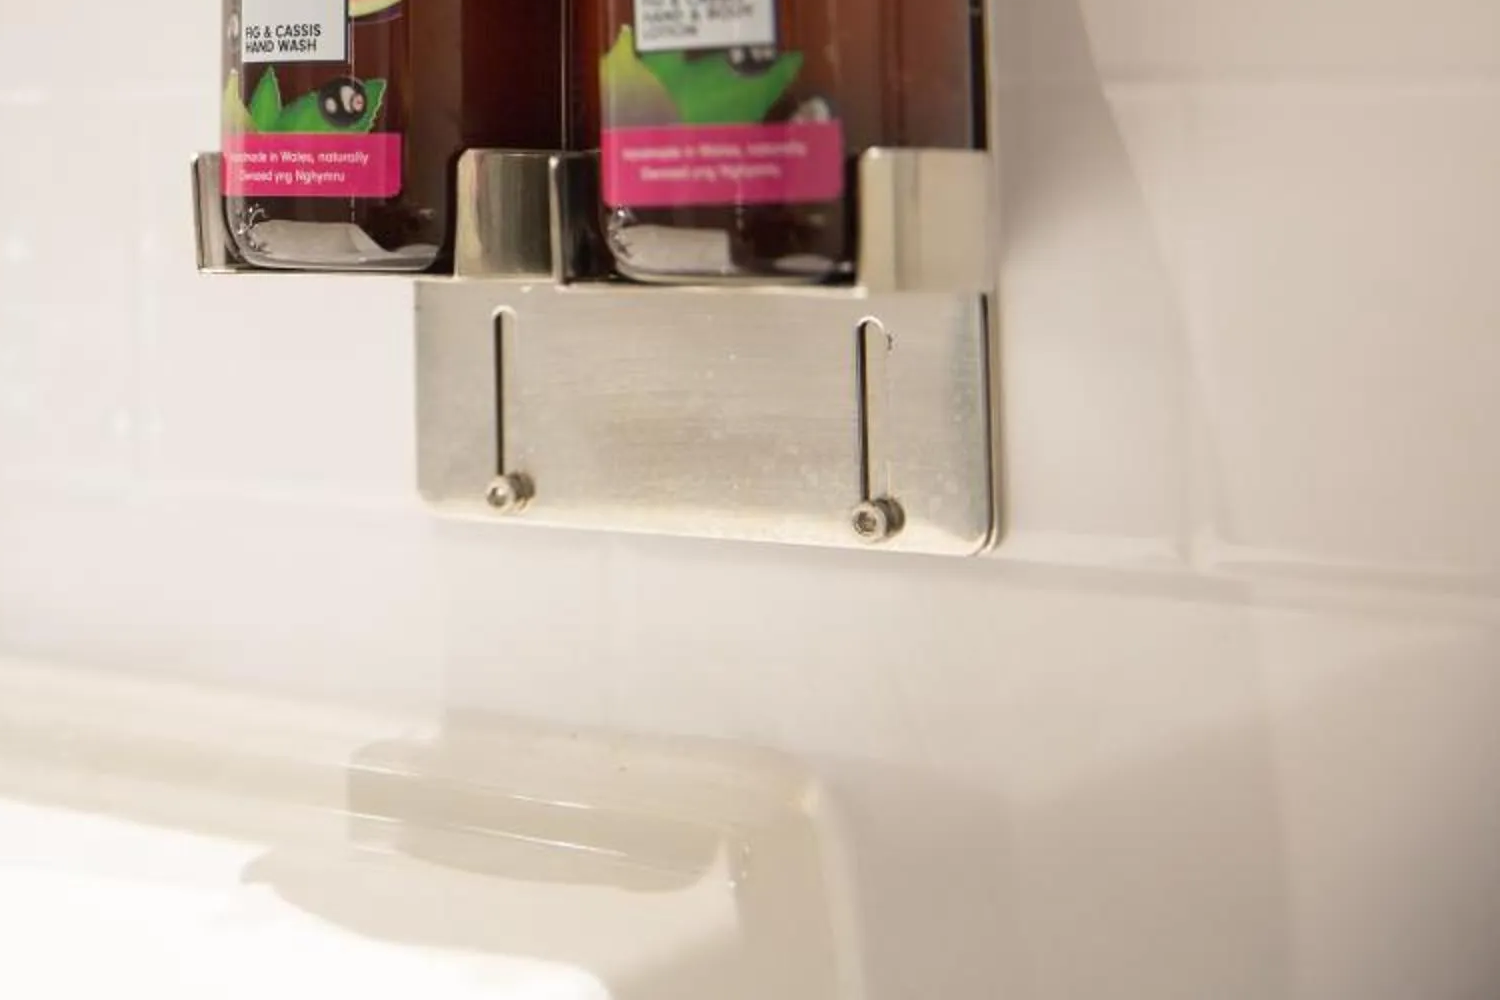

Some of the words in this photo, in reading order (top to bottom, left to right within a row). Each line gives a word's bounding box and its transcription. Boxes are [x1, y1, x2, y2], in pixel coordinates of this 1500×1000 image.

[275, 24, 321, 37] CASSIS
[245, 40, 275, 53] HAND
[278, 39, 317, 52] WASH
